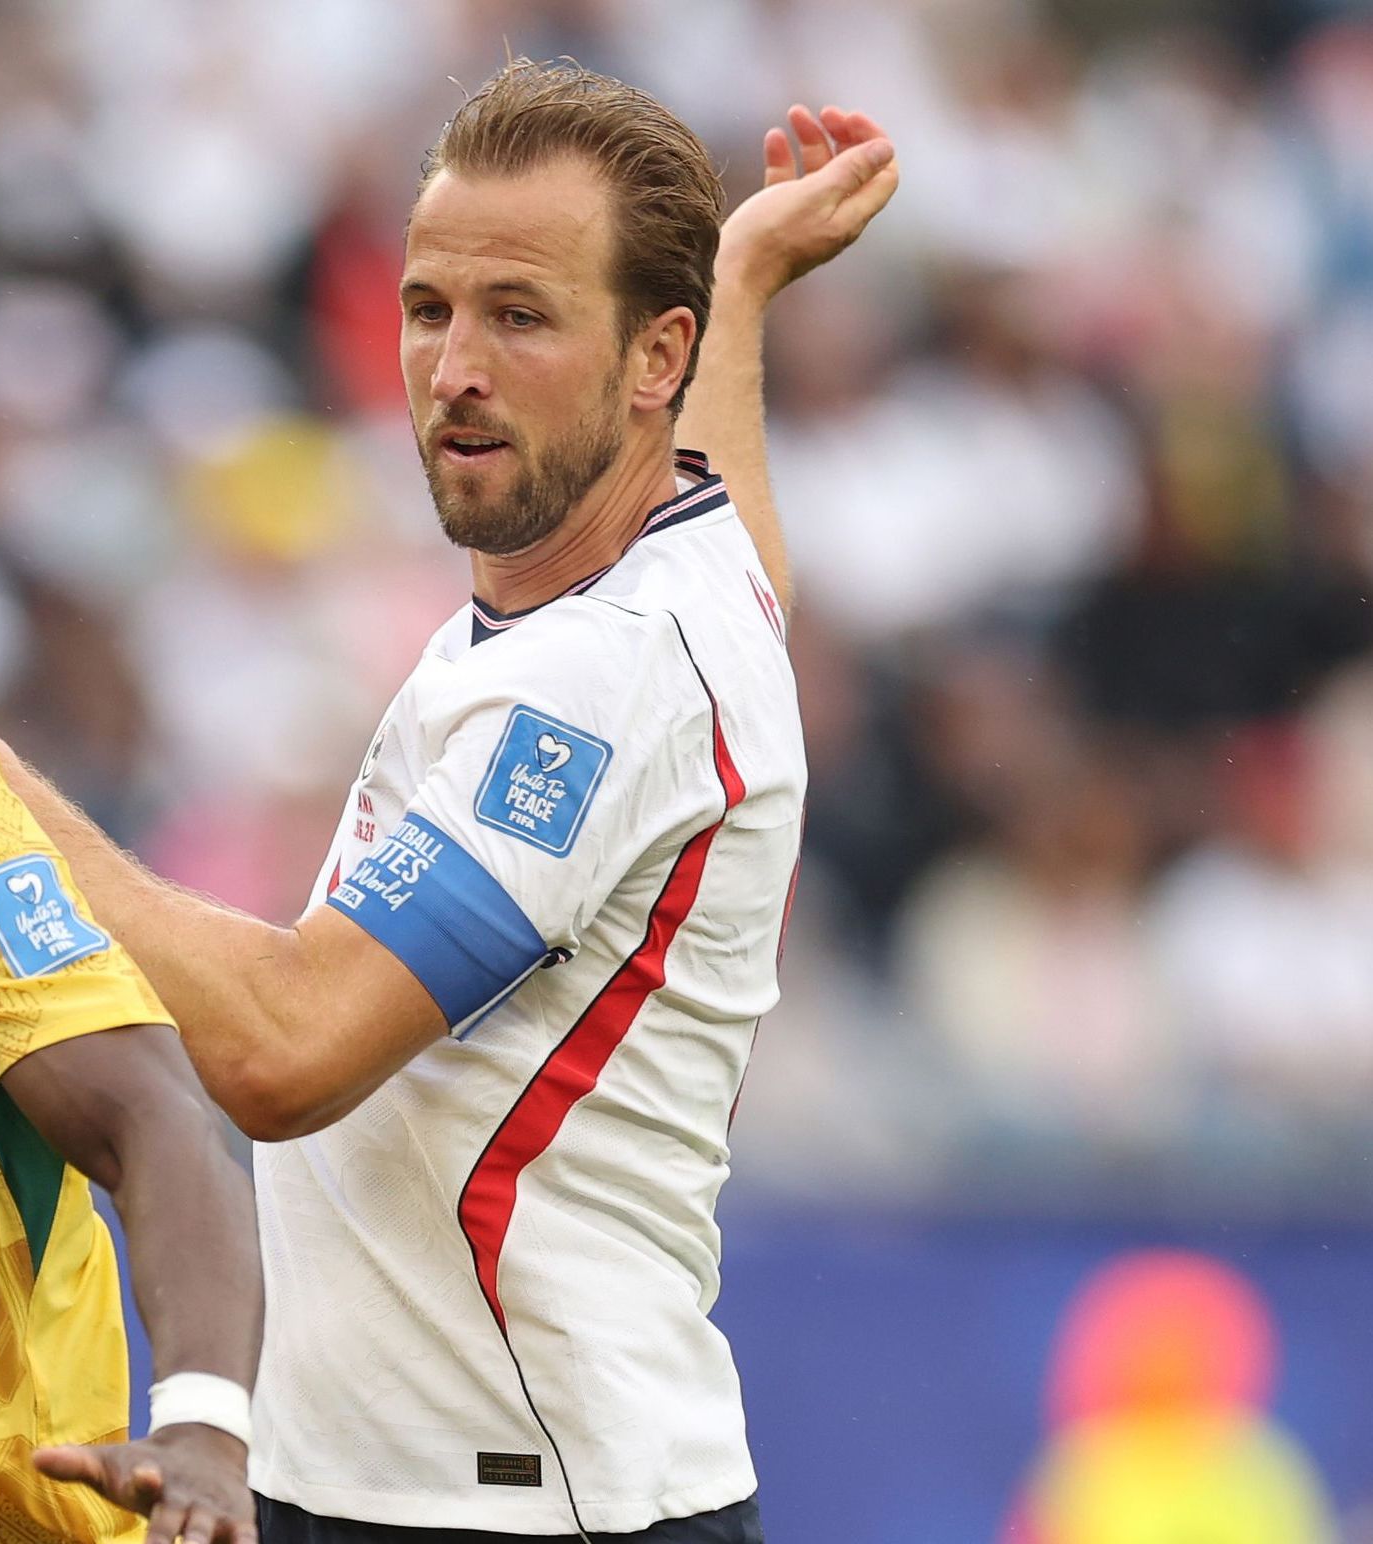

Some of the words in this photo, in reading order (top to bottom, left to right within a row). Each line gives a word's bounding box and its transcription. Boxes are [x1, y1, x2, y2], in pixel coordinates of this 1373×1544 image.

[505, 784, 557, 823] PEACE
[508, 810, 537, 831] FIFA
[393, 820, 444, 864] TBALL
